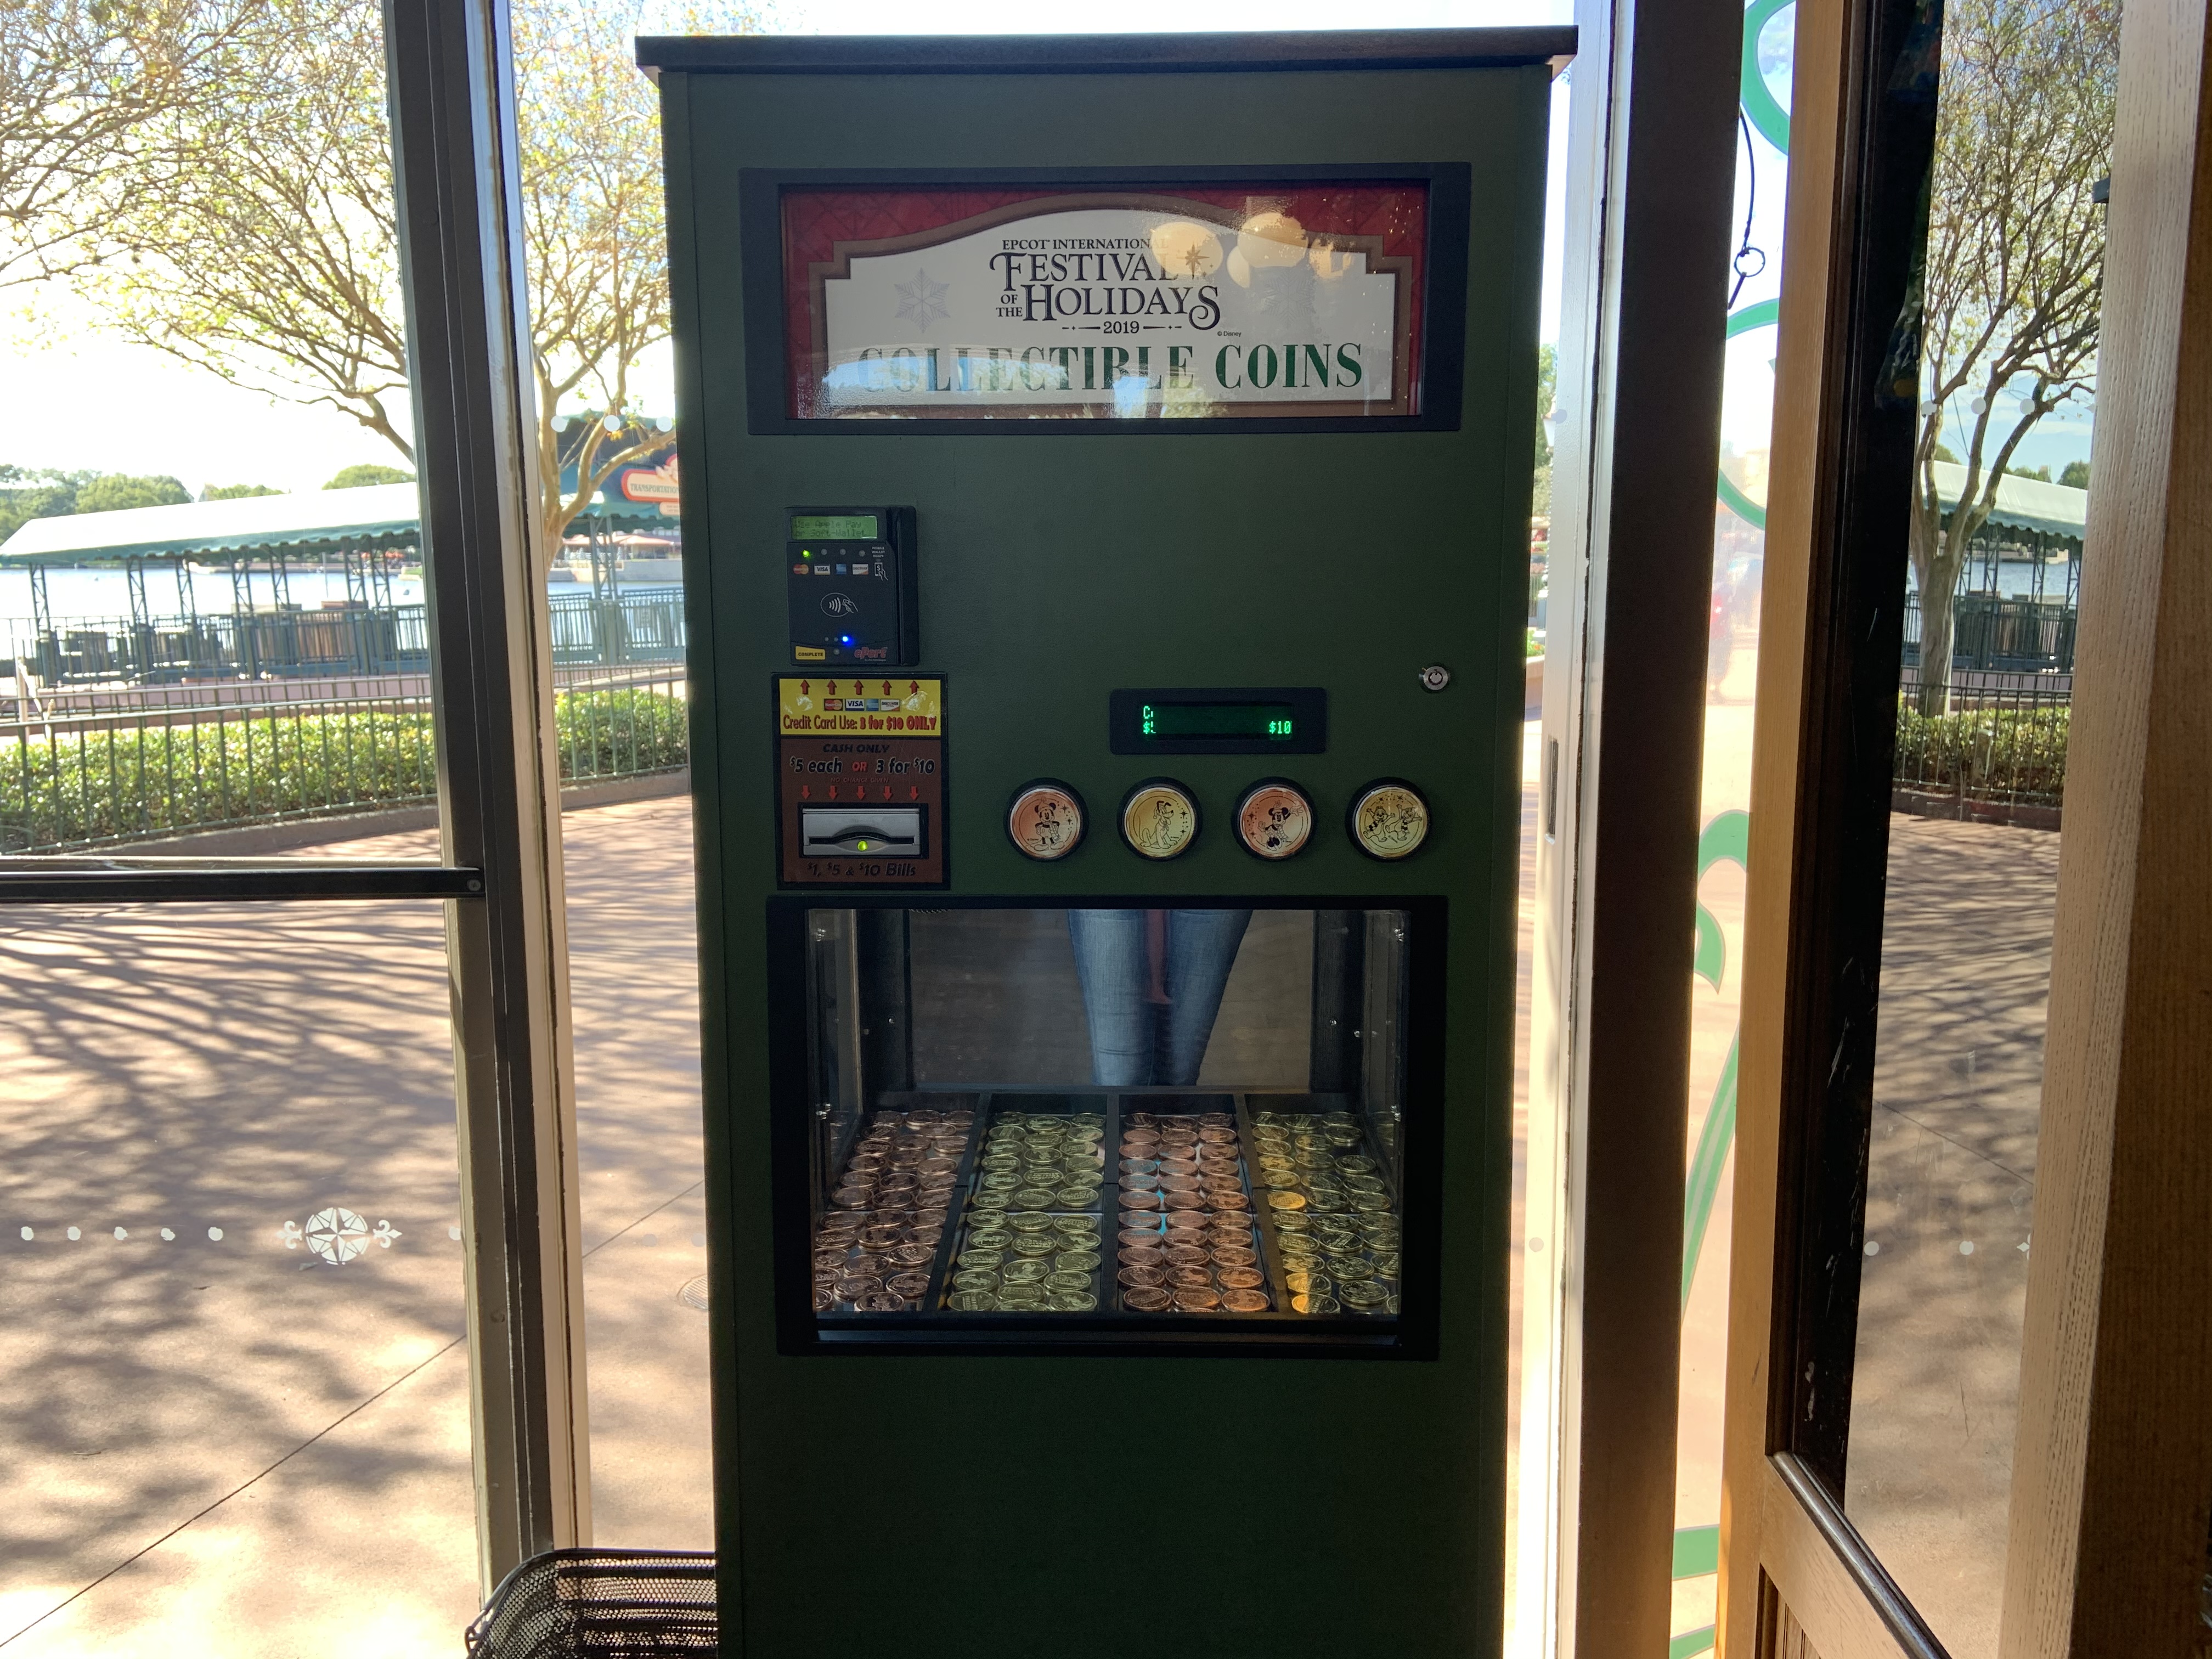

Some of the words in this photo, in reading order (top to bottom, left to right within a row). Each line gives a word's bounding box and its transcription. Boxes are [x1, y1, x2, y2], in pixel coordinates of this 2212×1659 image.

[1002, 239, 1050, 250] EPCOT
[989, 252, 1179, 291] FESTIVAL
[1001, 294, 1018, 304] OF
[996, 307, 1023, 318] THE
[1020, 284, 1221, 330] HOLIDAYS
[1103, 320, 1140, 334] 2019
[858, 345, 1194, 392] COLLECTIBLE
[1215, 343, 1362, 389] COINS
[783, 714, 812, 730] Credit
[814, 714, 837, 730] Card
[839, 715, 857, 730] Use:
[868, 715, 884, 730] for
[886, 715, 904, 731] $10
[906, 715, 937, 730] ONLY
[1269, 720, 1293, 734] $10
[823, 744, 854, 753] CASH
[856, 744, 890, 753] ONLY
[790, 755, 804, 773] $5
[808, 756, 843, 773] each
[851, 761, 868, 772] OR
[875, 758, 885, 774] 3
[888, 757, 911, 774] for
[914, 757, 935, 774] $10
[827, 861, 840, 876] $5
[845, 866, 855, 876] &
[859, 861, 881, 876] $10
[885, 862, 916, 876] Bills
